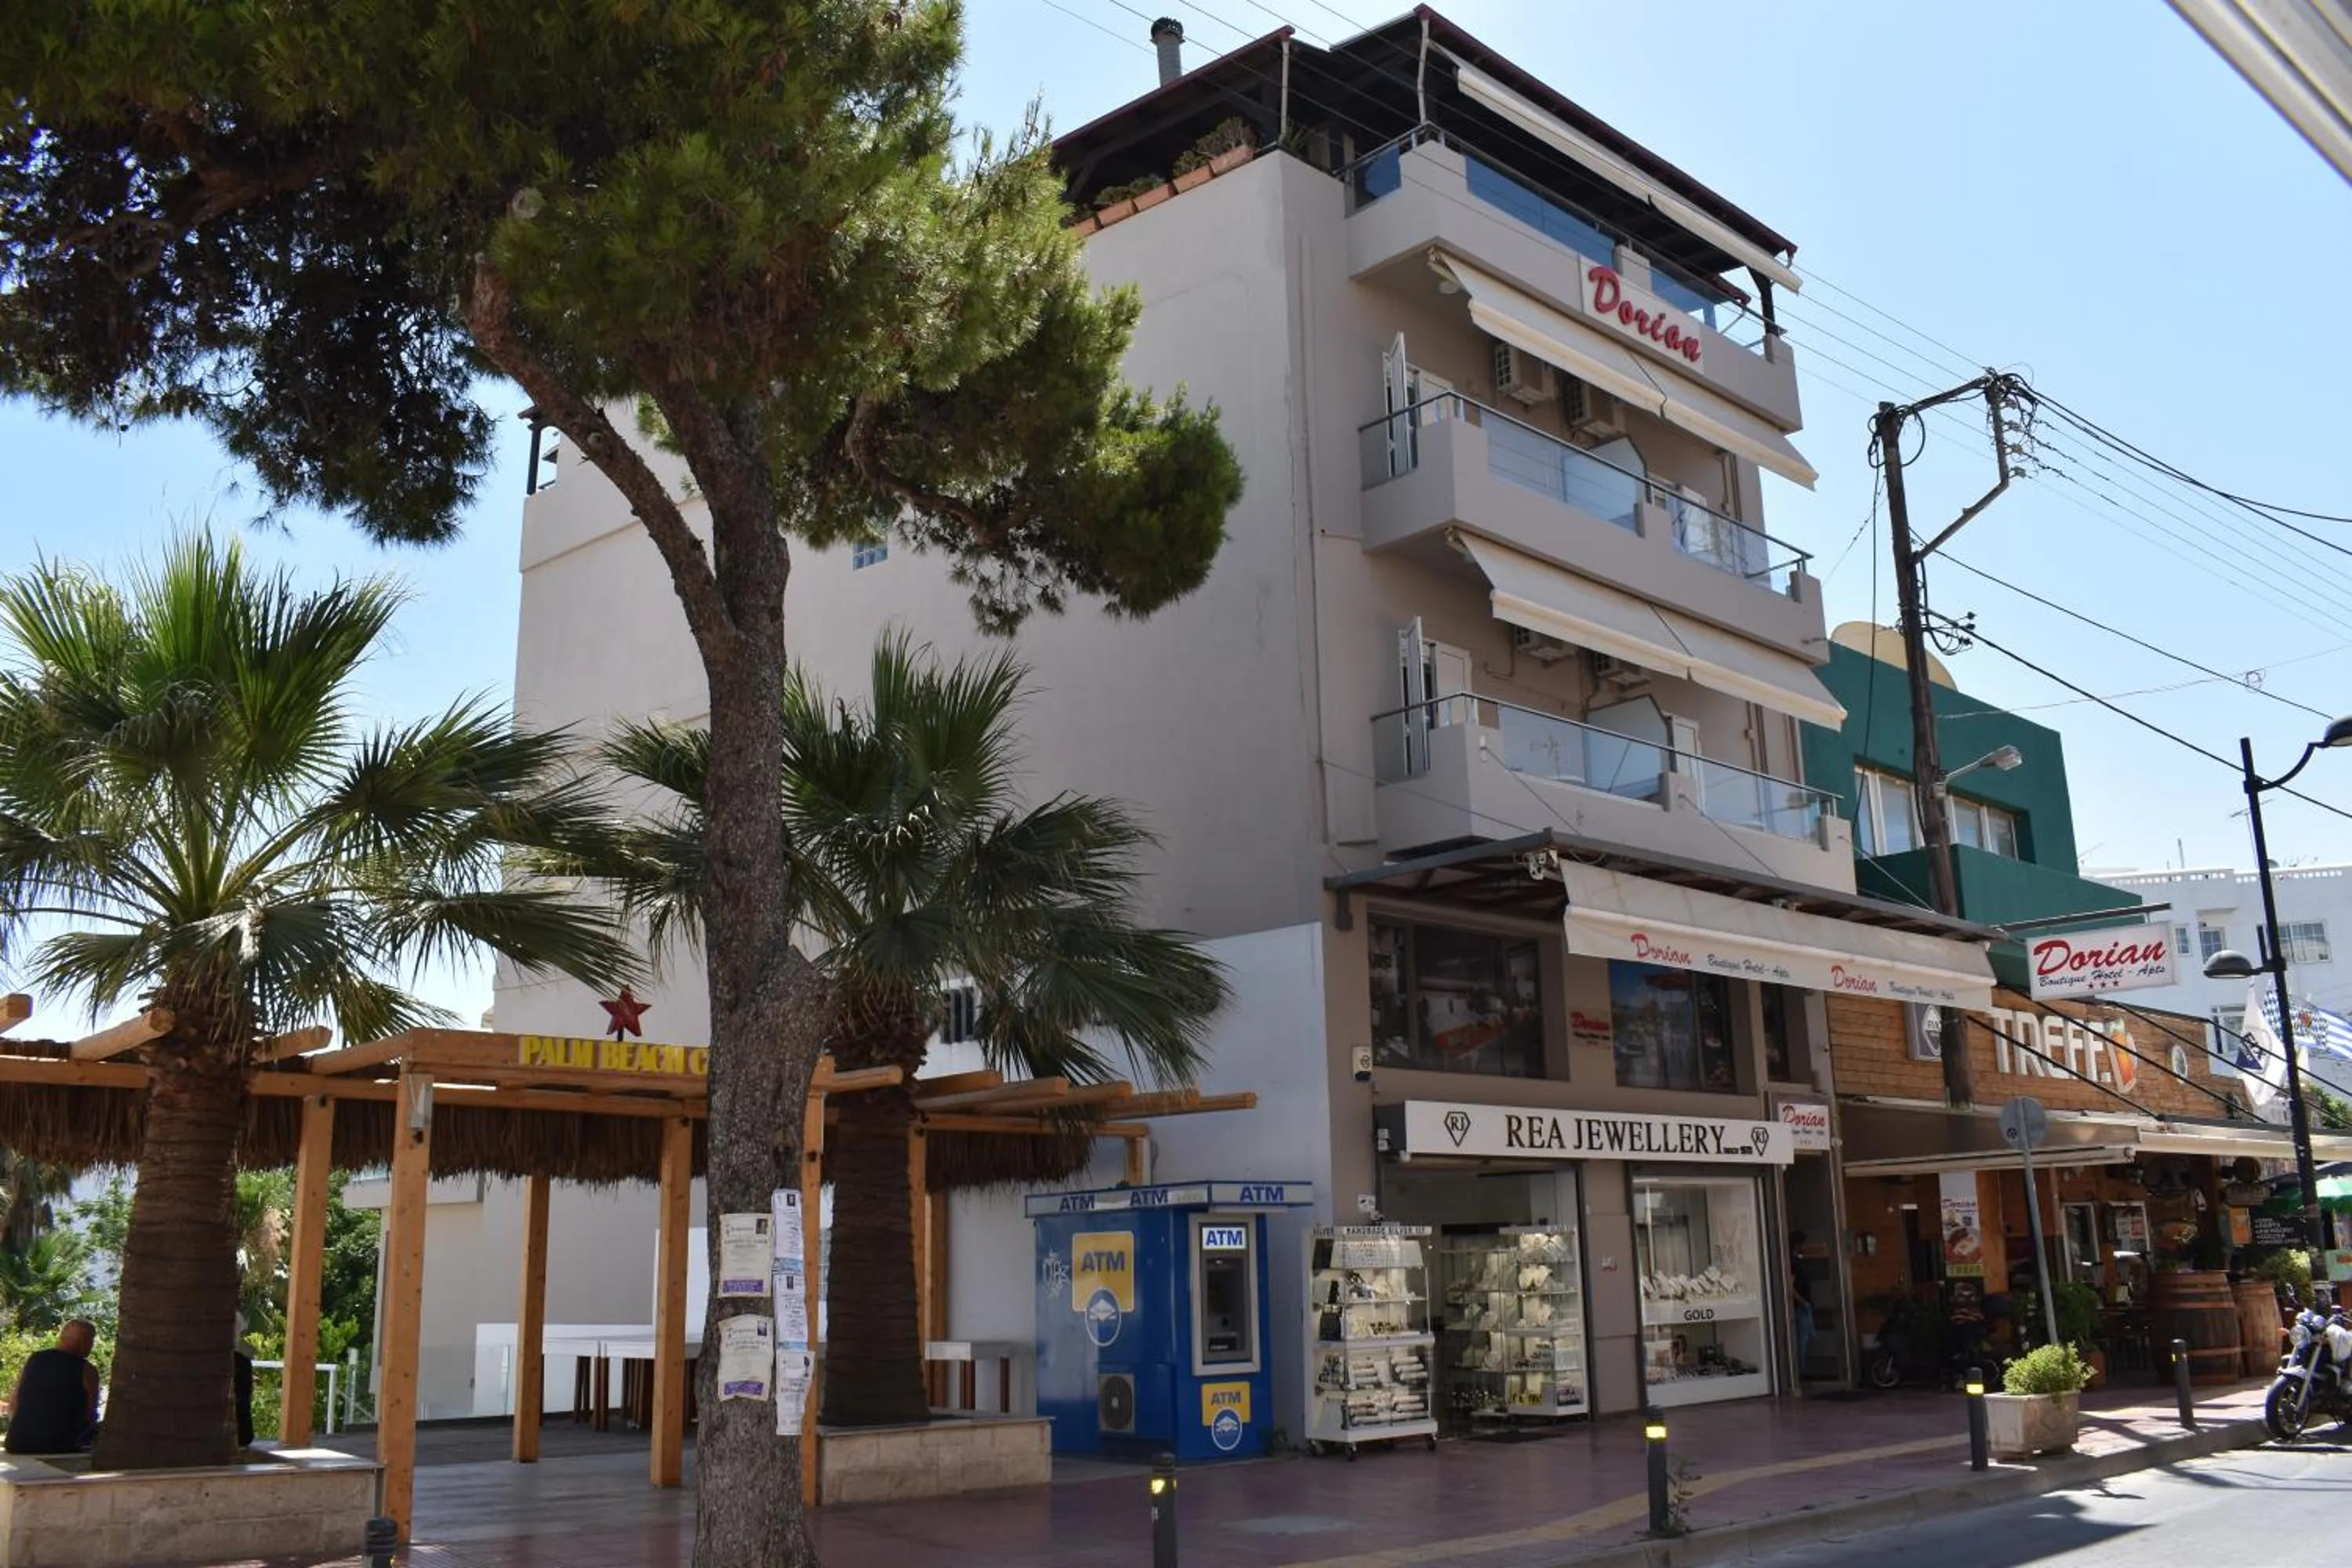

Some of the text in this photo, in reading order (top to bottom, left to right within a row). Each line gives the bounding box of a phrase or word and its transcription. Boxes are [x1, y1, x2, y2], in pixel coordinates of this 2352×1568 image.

[1588, 267, 1701, 362] Dorian
[1631, 934, 1691, 965] Dorian
[2034, 939, 2166, 976] Dorian
[1831, 965, 1878, 993] Dorian
[2039, 975, 2086, 986] Boutique
[2092, 968, 2123, 980] Hotel
[2136, 964, 2165, 977] Apts
[519, 1036, 593, 1069] PALM
[600, 1041, 684, 1073] BEACH
[1782, 1105, 1826, 1127] Dorian
[1505, 1114, 1725, 1155] REA JEWELLERY
[1058, 1195, 1095, 1211] ATM
[1129, 1189, 1169, 1207] ATM
[1240, 1185, 1284, 1202] ATM
[1205, 1230, 1244, 1247] ATM
[1080, 1250, 1125, 1273] ATM
[1683, 1308, 1715, 1320] GOLD
[1210, 1391, 1241, 1406] ATM
